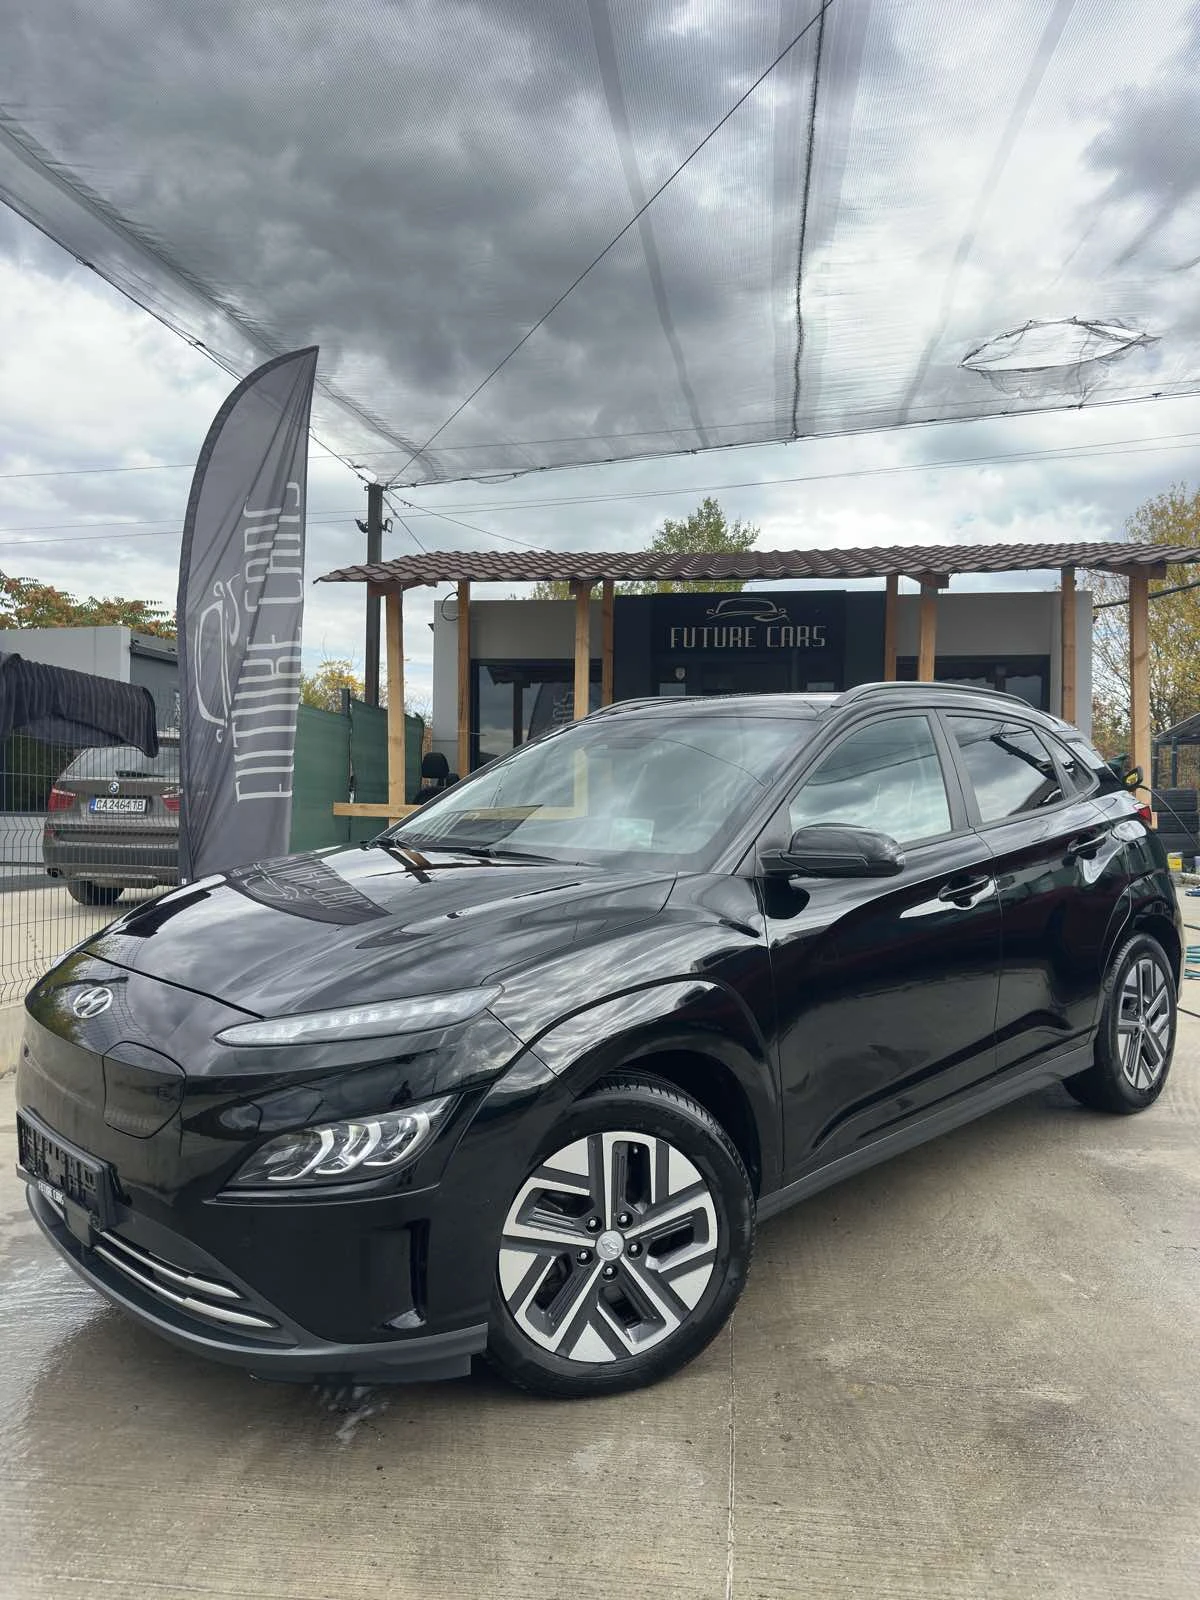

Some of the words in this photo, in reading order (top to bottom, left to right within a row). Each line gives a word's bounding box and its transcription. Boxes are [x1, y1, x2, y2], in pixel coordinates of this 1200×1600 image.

[670, 627, 757, 648] FUTURE
[766, 625, 827, 648] CARS
[231, 625, 302, 803] FUTURE
